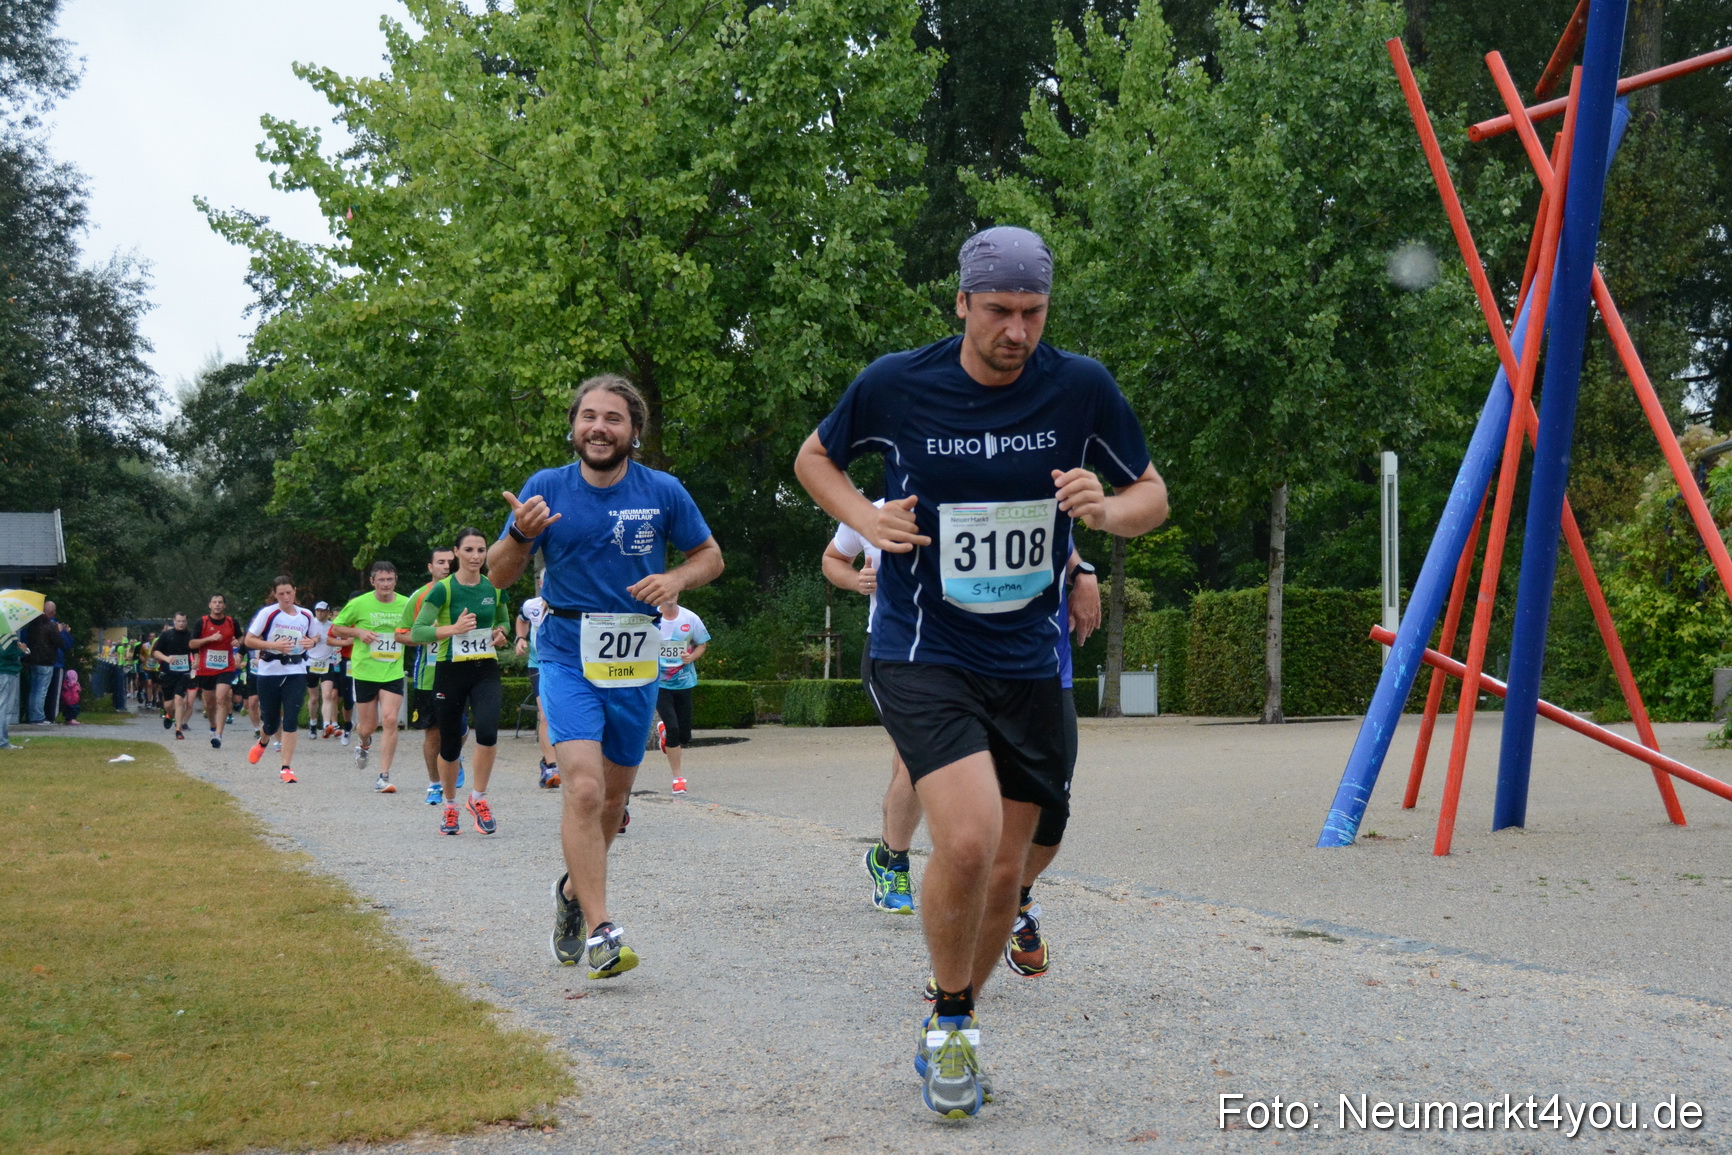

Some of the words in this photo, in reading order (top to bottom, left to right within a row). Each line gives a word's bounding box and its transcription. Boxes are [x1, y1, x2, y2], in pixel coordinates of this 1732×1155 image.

[926, 437, 982, 456] EURO
[1000, 430, 1057, 453] POLES
[620, 508, 660, 516] NEUMARKTER
[995, 503, 1049, 520] BOCK
[950, 516, 989, 524] NeuerMarkt
[953, 527, 1046, 572] 3108
[971, 581, 1022, 598] Stephan
[377, 640, 396, 651] 214
[461, 638, 487, 653] 314
[598, 631, 648, 659] 207
[208, 654, 227, 663] 2882
[660, 646, 685, 658] 2587
[608, 665, 635, 677] Frank
